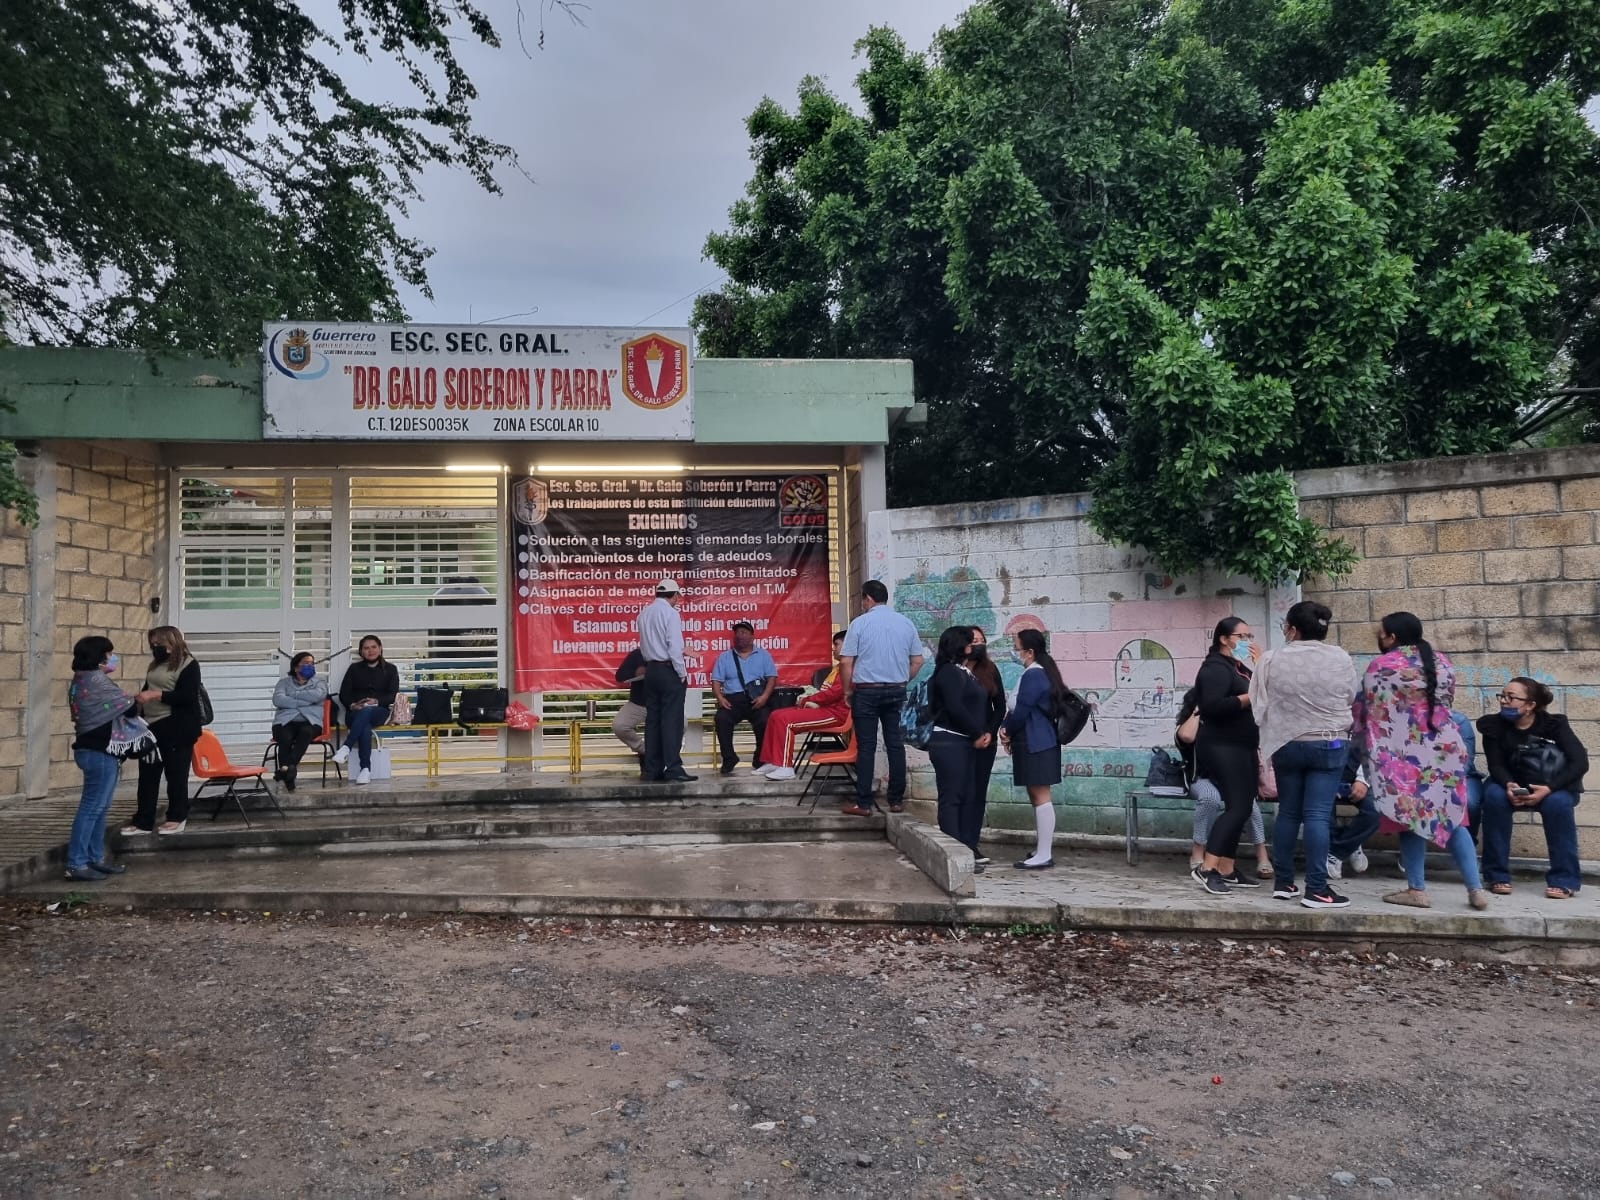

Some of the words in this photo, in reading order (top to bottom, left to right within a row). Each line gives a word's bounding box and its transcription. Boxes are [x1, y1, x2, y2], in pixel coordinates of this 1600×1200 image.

[312, 327, 376, 342] Guerrero
[390, 332, 439, 352] ESC.
[446, 332, 492, 353] SEC.
[499, 333, 569, 353] GRAL.
[444, 367, 530, 410] SOBERON
[534, 368, 546, 410] Y
[551, 368, 618, 410] PARRA"
[493, 417, 526, 432] ZONA
[530, 417, 585, 431] ESCOLAR
[587, 418, 599, 431] 10
[549, 479, 573, 492] Esc.
[575, 479, 600, 492] Sec.
[602, 479, 629, 492] Gral.
[656, 479, 683, 492] Galo
[685, 478, 734, 492] Soberón
[736, 481, 743, 493] y
[745, 479, 776, 492] Parra
[547, 498, 564, 509] Los
[566, 497, 632, 510] trabajadores
[633, 498, 646, 509] de
[648, 498, 670, 509] esta
[671, 497, 725, 509] institución
[727, 496, 776, 508] educativa
[628, 513, 698, 530] EXIGIMOS
[529, 534, 587, 546] Solución
[591, 537, 599, 545] a
[602, 535, 622, 545] las
[625, 534, 692, 548] siguientes
[696, 533, 762, 545] demandas
[766, 532, 828, 544] laborales:
[529, 551, 633, 563] Nombramientos
[637, 551, 654, 563] de
[657, 551, 694, 563] horas
[698, 551, 714, 562] de
[717, 550, 772, 561] adeudos
[529, 567, 611, 580] Basificación
[614, 568, 631, 580] de
[634, 568, 736, 580] nombramientos
[739, 566, 798, 578] limitados
[529, 585, 604, 599] Asignación
[608, 585, 624, 597] de
[680, 584, 727, 596] escolar
[729, 586, 745, 595] en
[749, 584, 761, 595] el
[764, 583, 789, 595] T.M.
[529, 602, 574, 615] Claves
[578, 602, 594, 614] de
[598, 602, 649, 614] direcci
[673, 601, 758, 613] subdirección
[573, 619, 628, 633] Estamos
[704, 618, 725, 631] sin
[553, 640, 615, 654] Llevamos
[681, 637, 709, 651] ños
[711, 637, 731, 650] sin
[753, 636, 789, 649] ución
[694, 672, 708, 685] YA
[1102, 763, 1135, 777] POR
